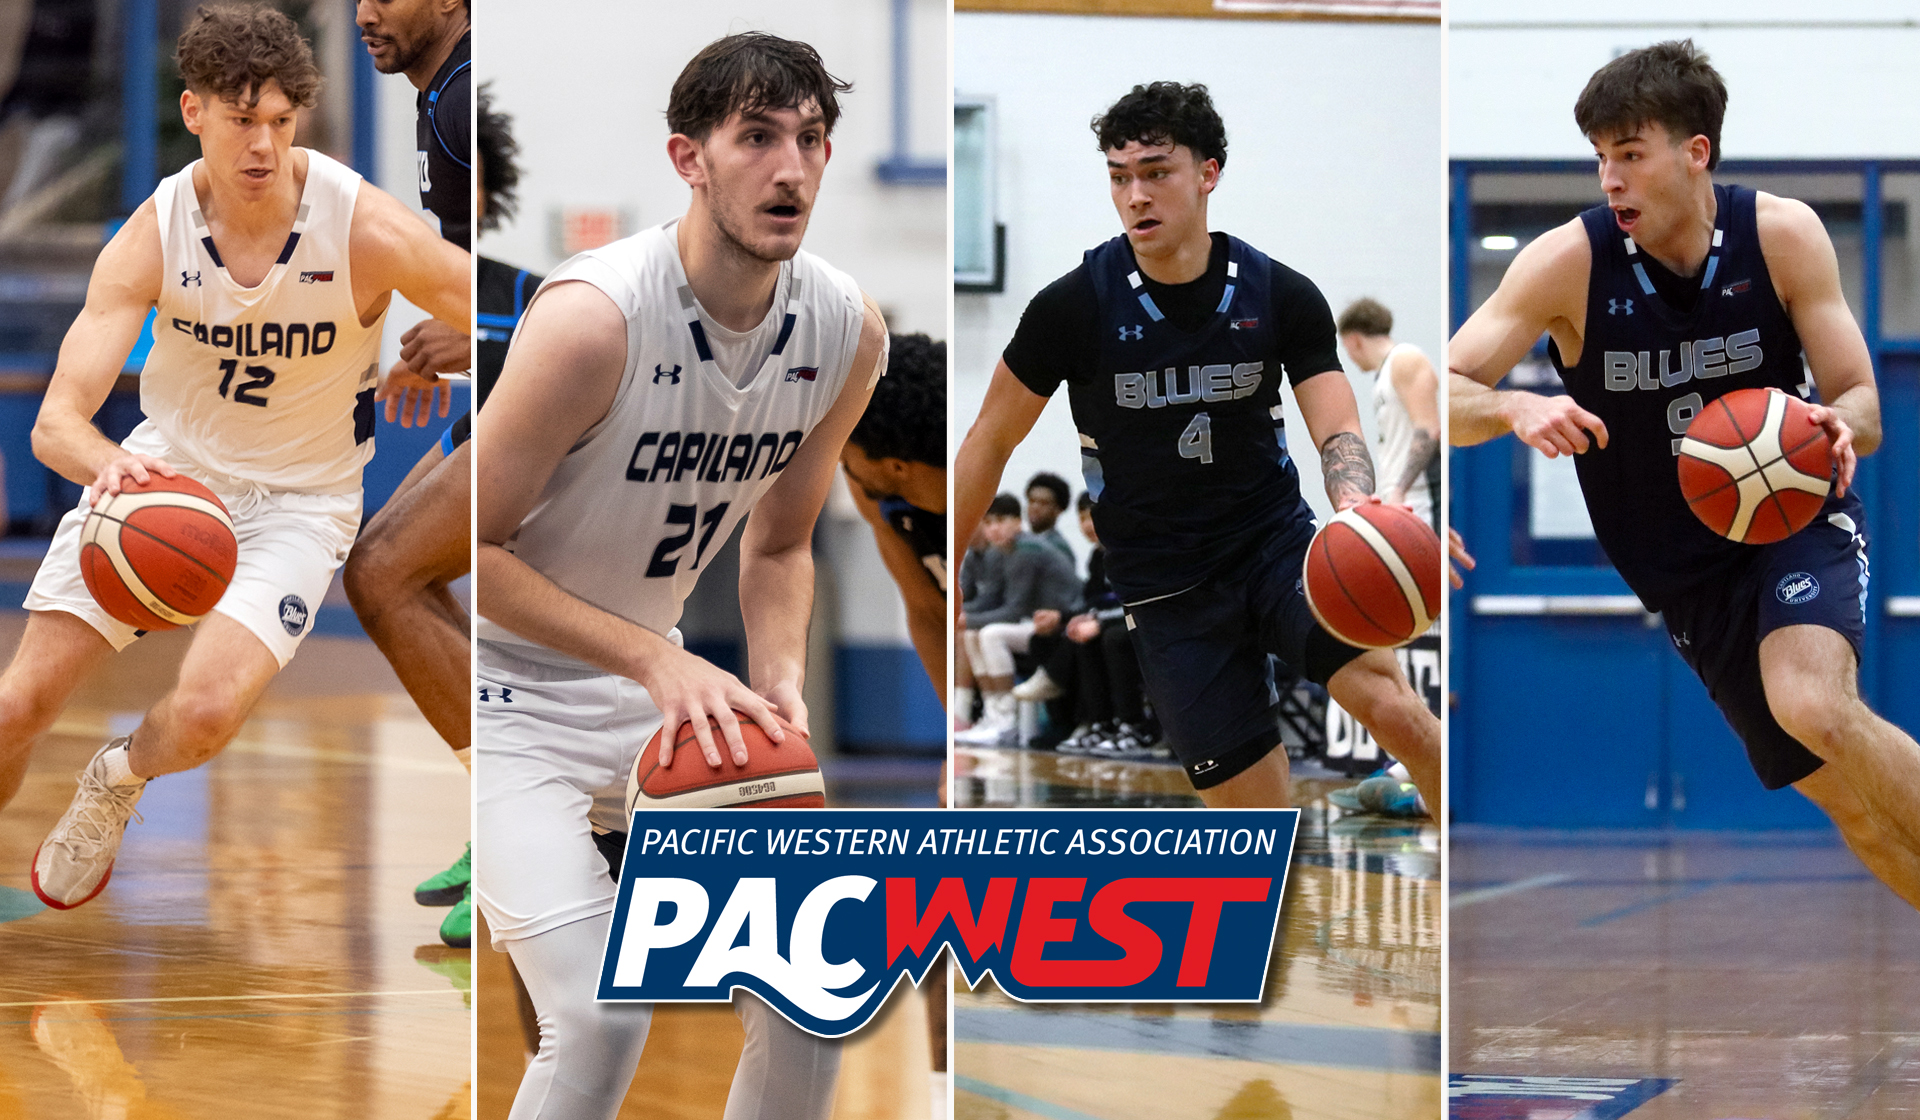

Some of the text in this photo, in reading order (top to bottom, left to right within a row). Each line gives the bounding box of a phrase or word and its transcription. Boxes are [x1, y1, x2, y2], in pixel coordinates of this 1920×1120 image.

[172, 318, 336, 359] CAPILANO
[1604, 328, 1764, 392] BLUES
[219, 358, 276, 408] 12
[1114, 360, 1264, 409] BLUES
[1178, 412, 1213, 464] 4
[1667, 392, 1704, 456] 9
[625, 430, 804, 483] CAPILANO
[644, 501, 731, 579] 21
[1782, 576, 1811, 601] Blues
